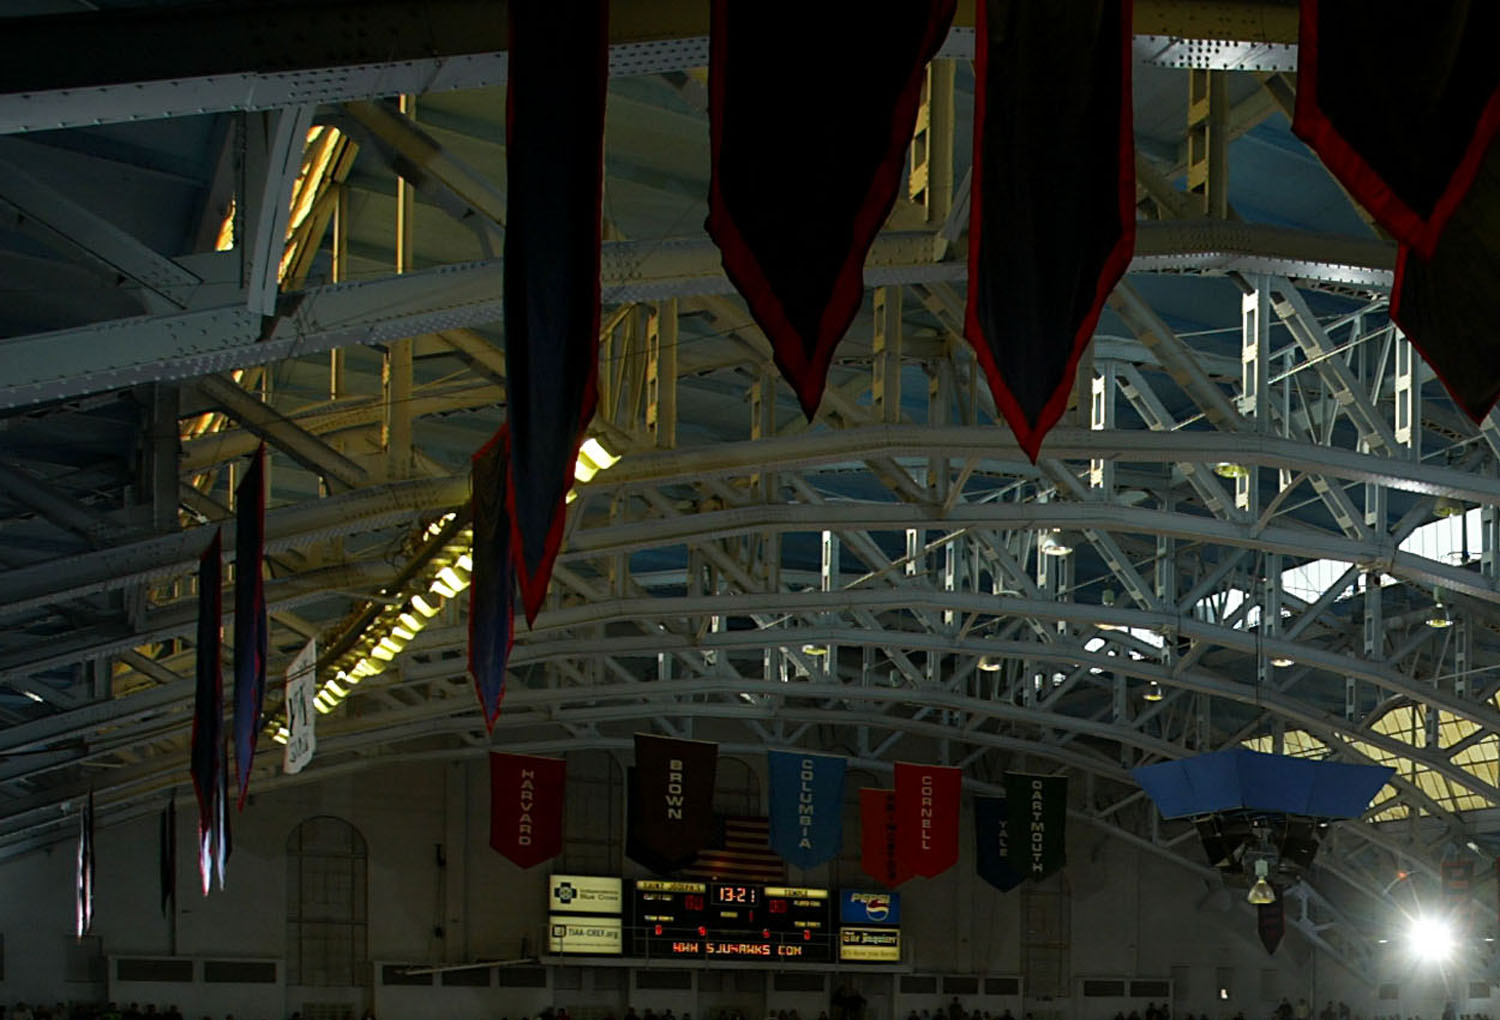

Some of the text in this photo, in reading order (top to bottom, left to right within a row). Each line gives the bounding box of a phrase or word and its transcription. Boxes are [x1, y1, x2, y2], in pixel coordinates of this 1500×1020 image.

[518, 768, 536, 847] HARVARD
[665, 759, 685, 821] BROWN
[799, 759, 815, 850] COLUMBIA
[919, 775, 934, 851] CORNELL
[1029, 780, 1045, 873] DARTMOUTH
[996, 819, 1009, 858] YALE
[851, 893, 890, 904] PEPSI
